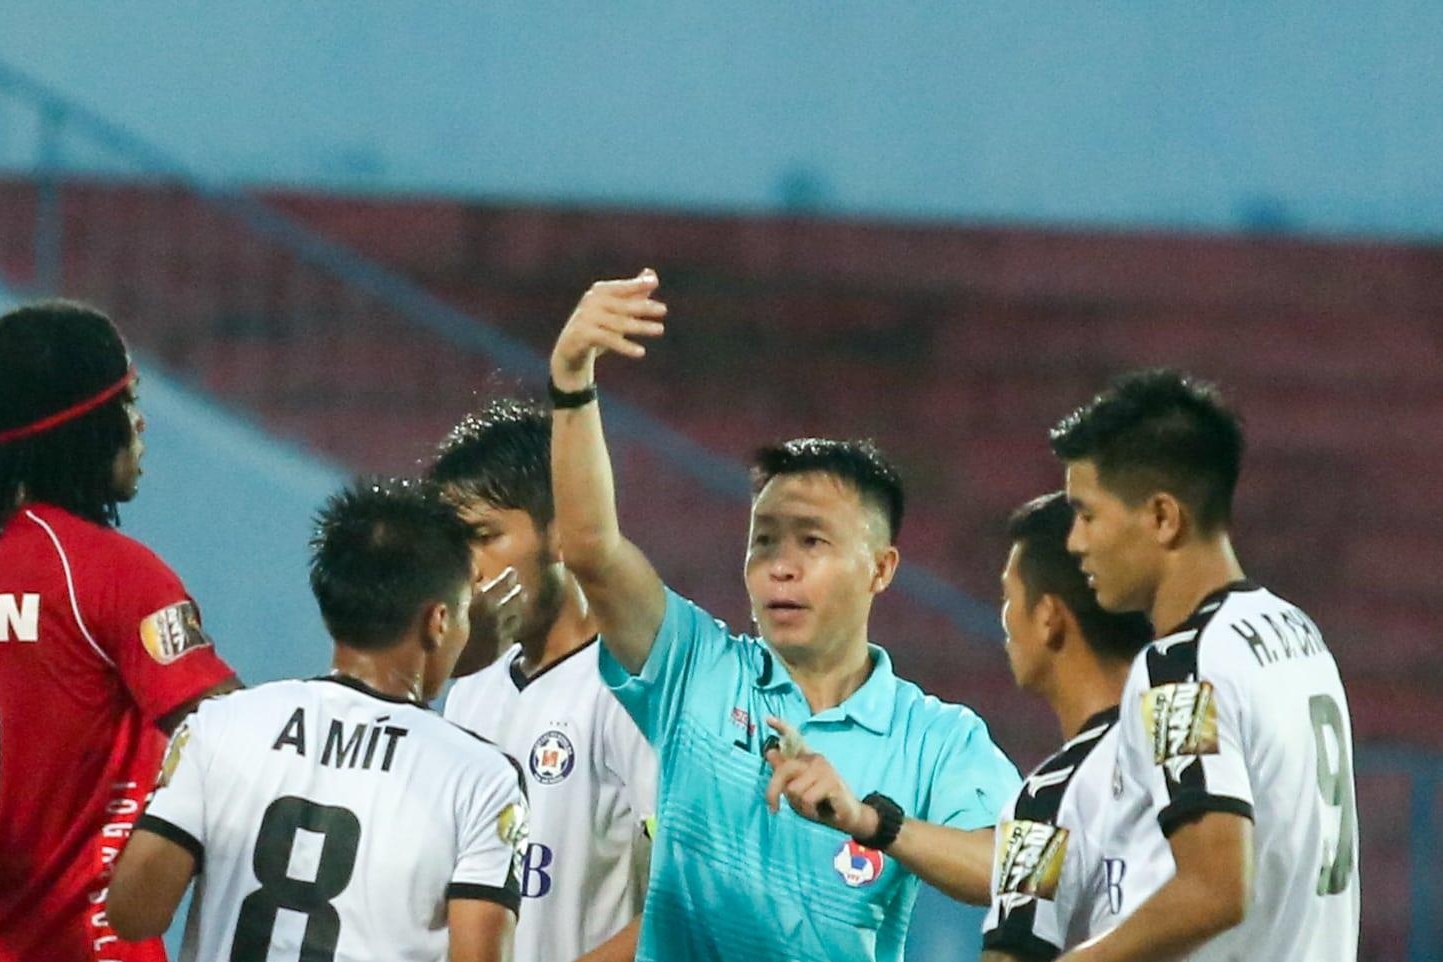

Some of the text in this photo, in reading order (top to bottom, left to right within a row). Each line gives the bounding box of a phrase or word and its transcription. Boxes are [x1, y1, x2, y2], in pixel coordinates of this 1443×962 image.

[271, 706, 409, 773] A MÍT
[1308, 694, 1354, 896] 9
